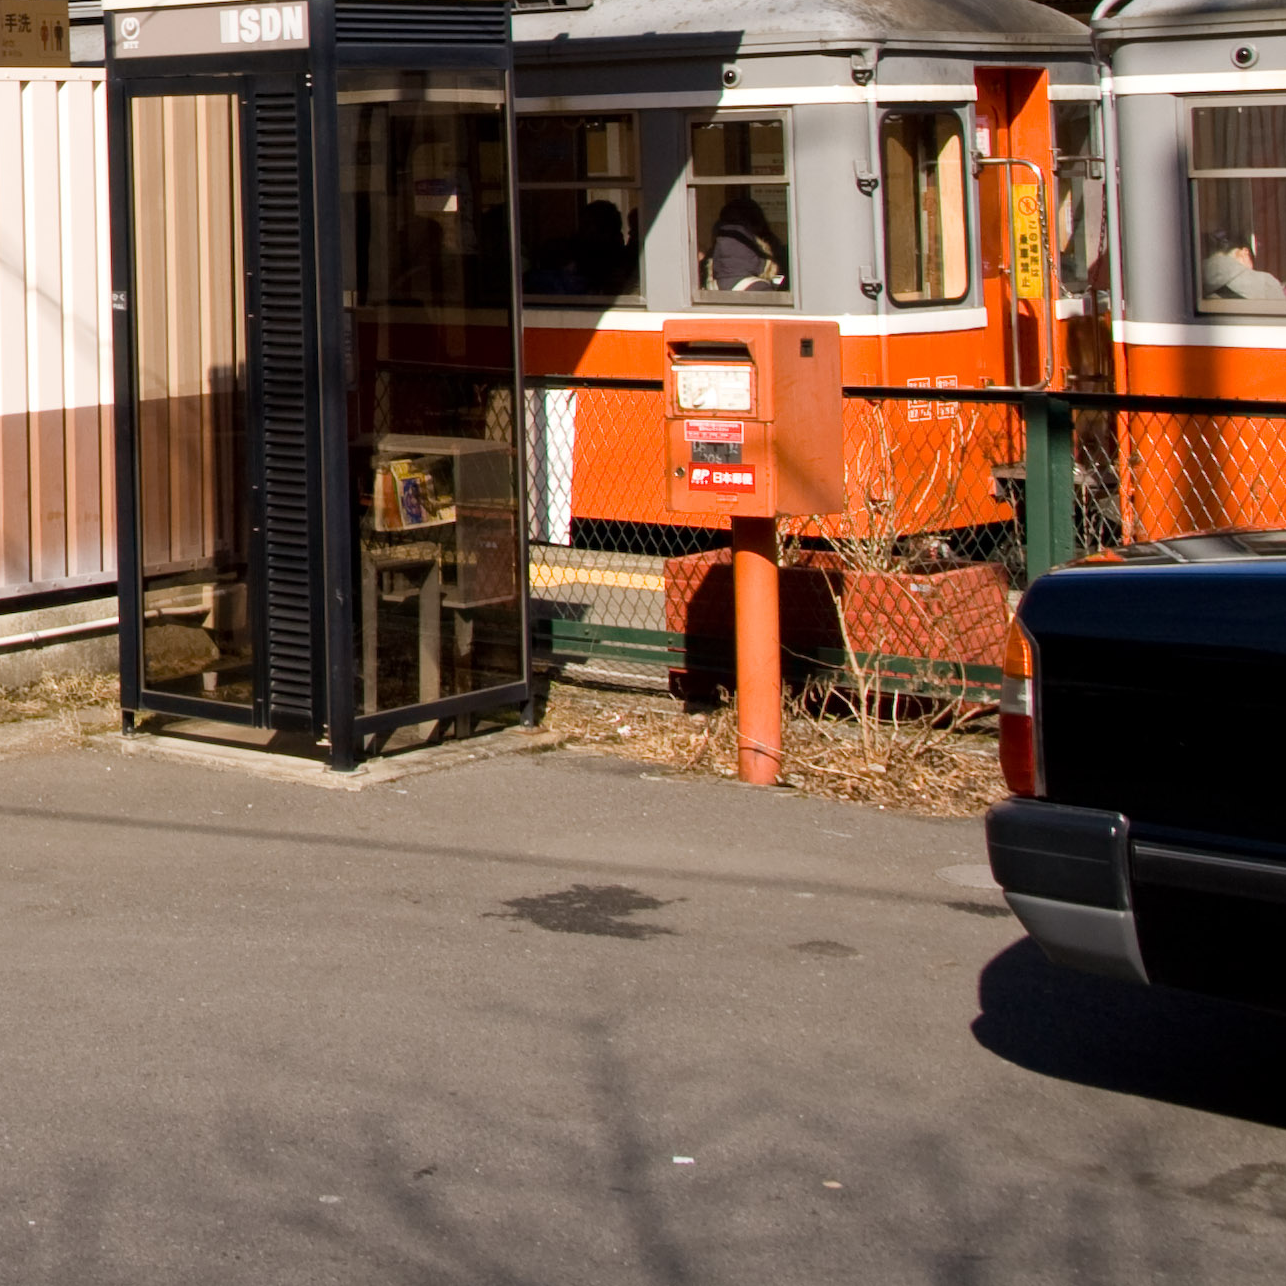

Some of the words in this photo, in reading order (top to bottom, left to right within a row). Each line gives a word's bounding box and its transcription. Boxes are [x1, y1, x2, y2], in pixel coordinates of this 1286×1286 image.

[220, 5, 304, 44] ISDN
[1028, 220, 1040, 278] この場所は
[712, 471, 754, 485] 日本郵便
